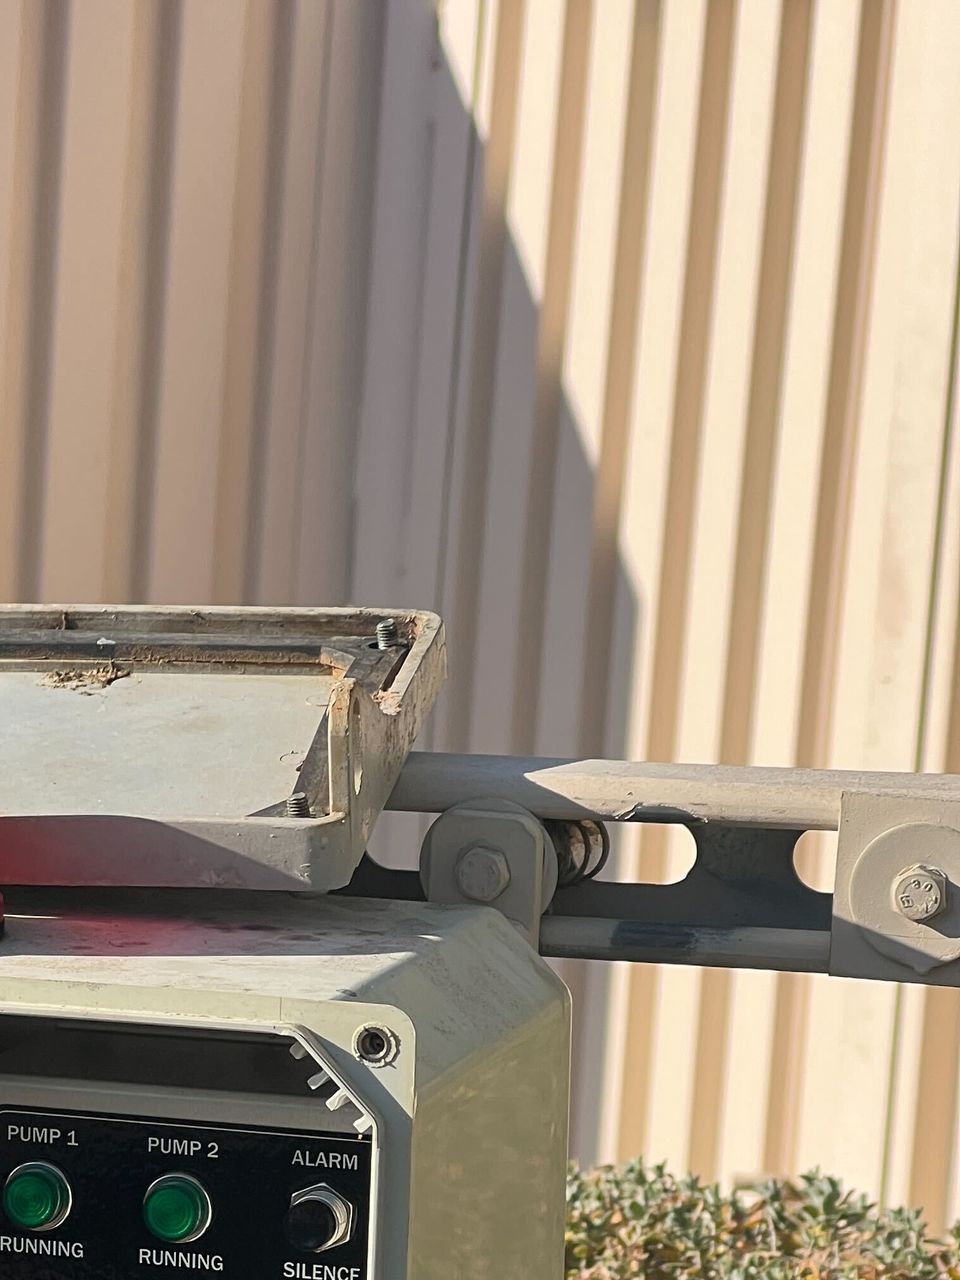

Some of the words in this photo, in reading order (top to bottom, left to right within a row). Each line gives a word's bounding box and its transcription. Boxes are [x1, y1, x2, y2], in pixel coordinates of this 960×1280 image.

[7, 1124, 61, 1146] PUMP
[66, 1130, 79, 1147] 1
[147, 1136, 202, 1158] PUMP
[207, 1142, 220, 1160] 2
[291, 1149, 359, 1172] ALARM
[0, 1235, 85, 1260] RUNNING
[138, 1248, 224, 1272] RUNNING
